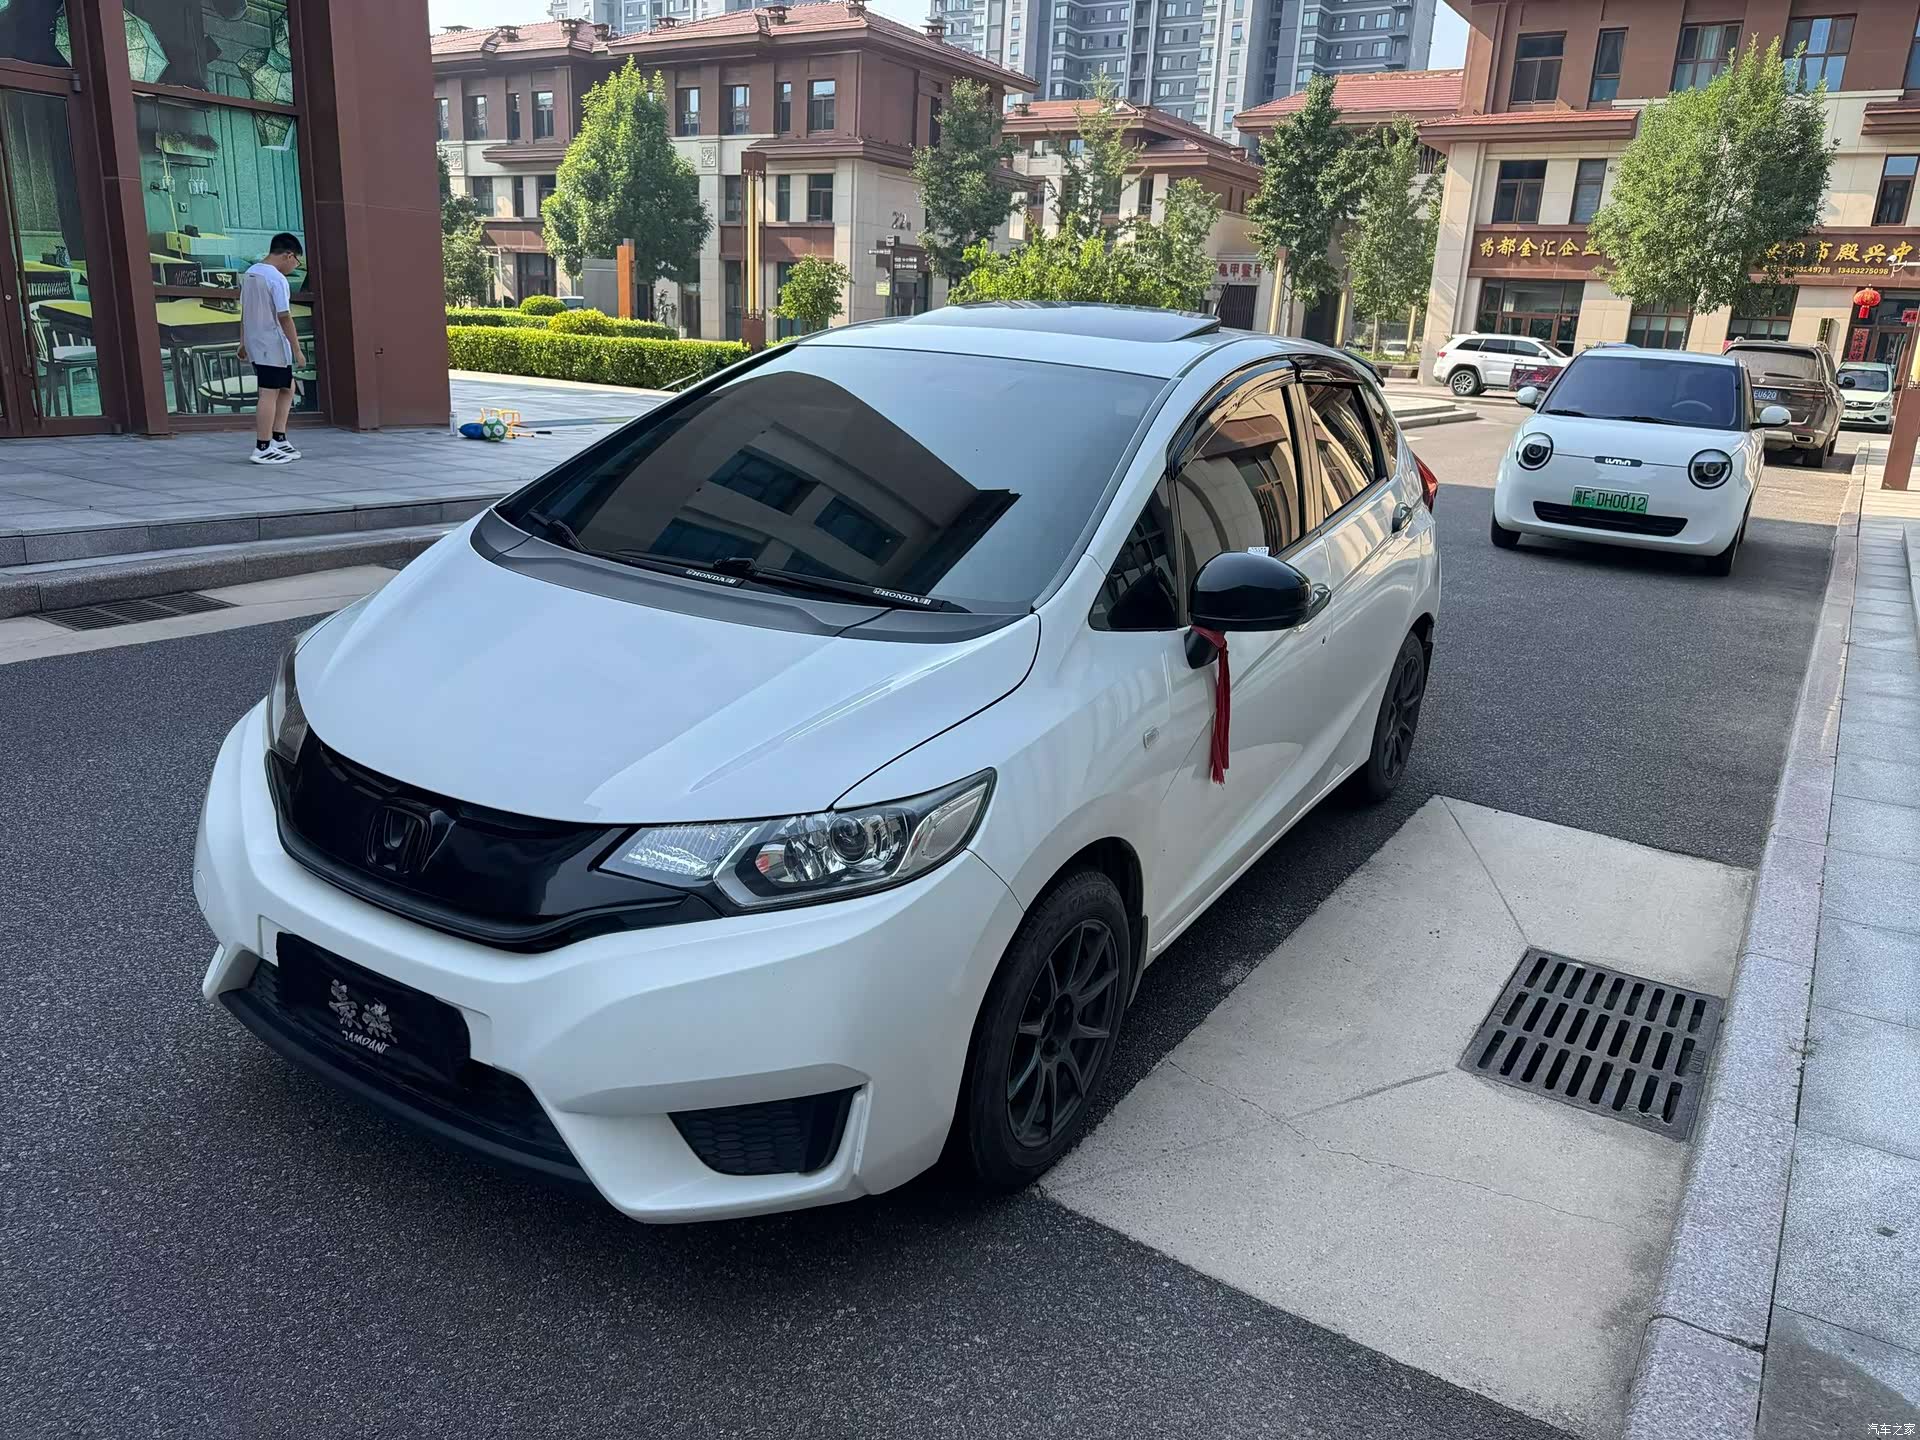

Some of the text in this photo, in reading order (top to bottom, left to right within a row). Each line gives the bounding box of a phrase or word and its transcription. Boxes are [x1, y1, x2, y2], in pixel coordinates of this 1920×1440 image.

[1479, 236, 1617, 259] 药都金汇企业
[1766, 240, 1920, 264] 市殿兴中
[1838, 266, 1889, 275] 13463275098
[692, 571, 725, 583] HONDA
[880, 590, 919, 603] HONDA
